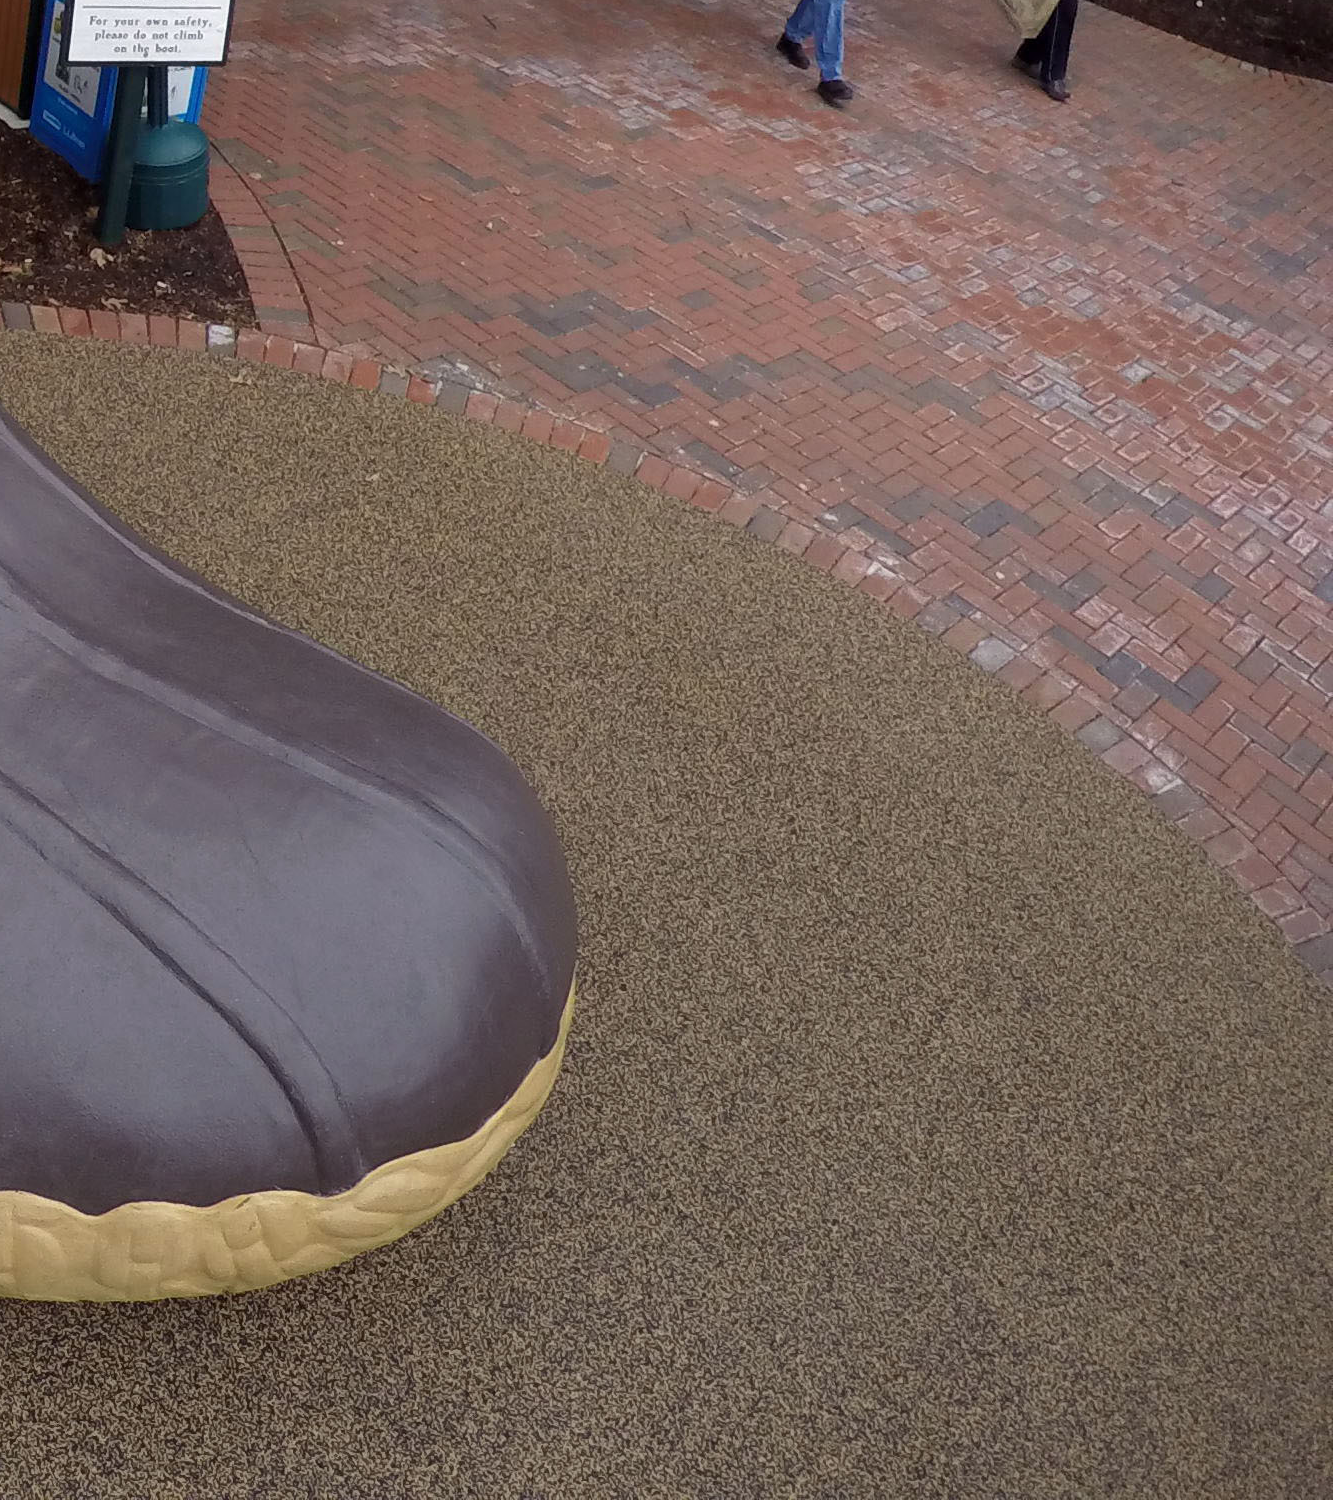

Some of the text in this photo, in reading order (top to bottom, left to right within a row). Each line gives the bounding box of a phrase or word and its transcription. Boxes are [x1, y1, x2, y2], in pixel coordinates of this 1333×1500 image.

[89, 15, 108, 26] For
[114, 18, 139, 30] your
[146, 18, 168, 27] own
[94, 29, 204, 42] please do not climb
[113, 45, 128, 53] on
[133, 43, 150, 53] the
